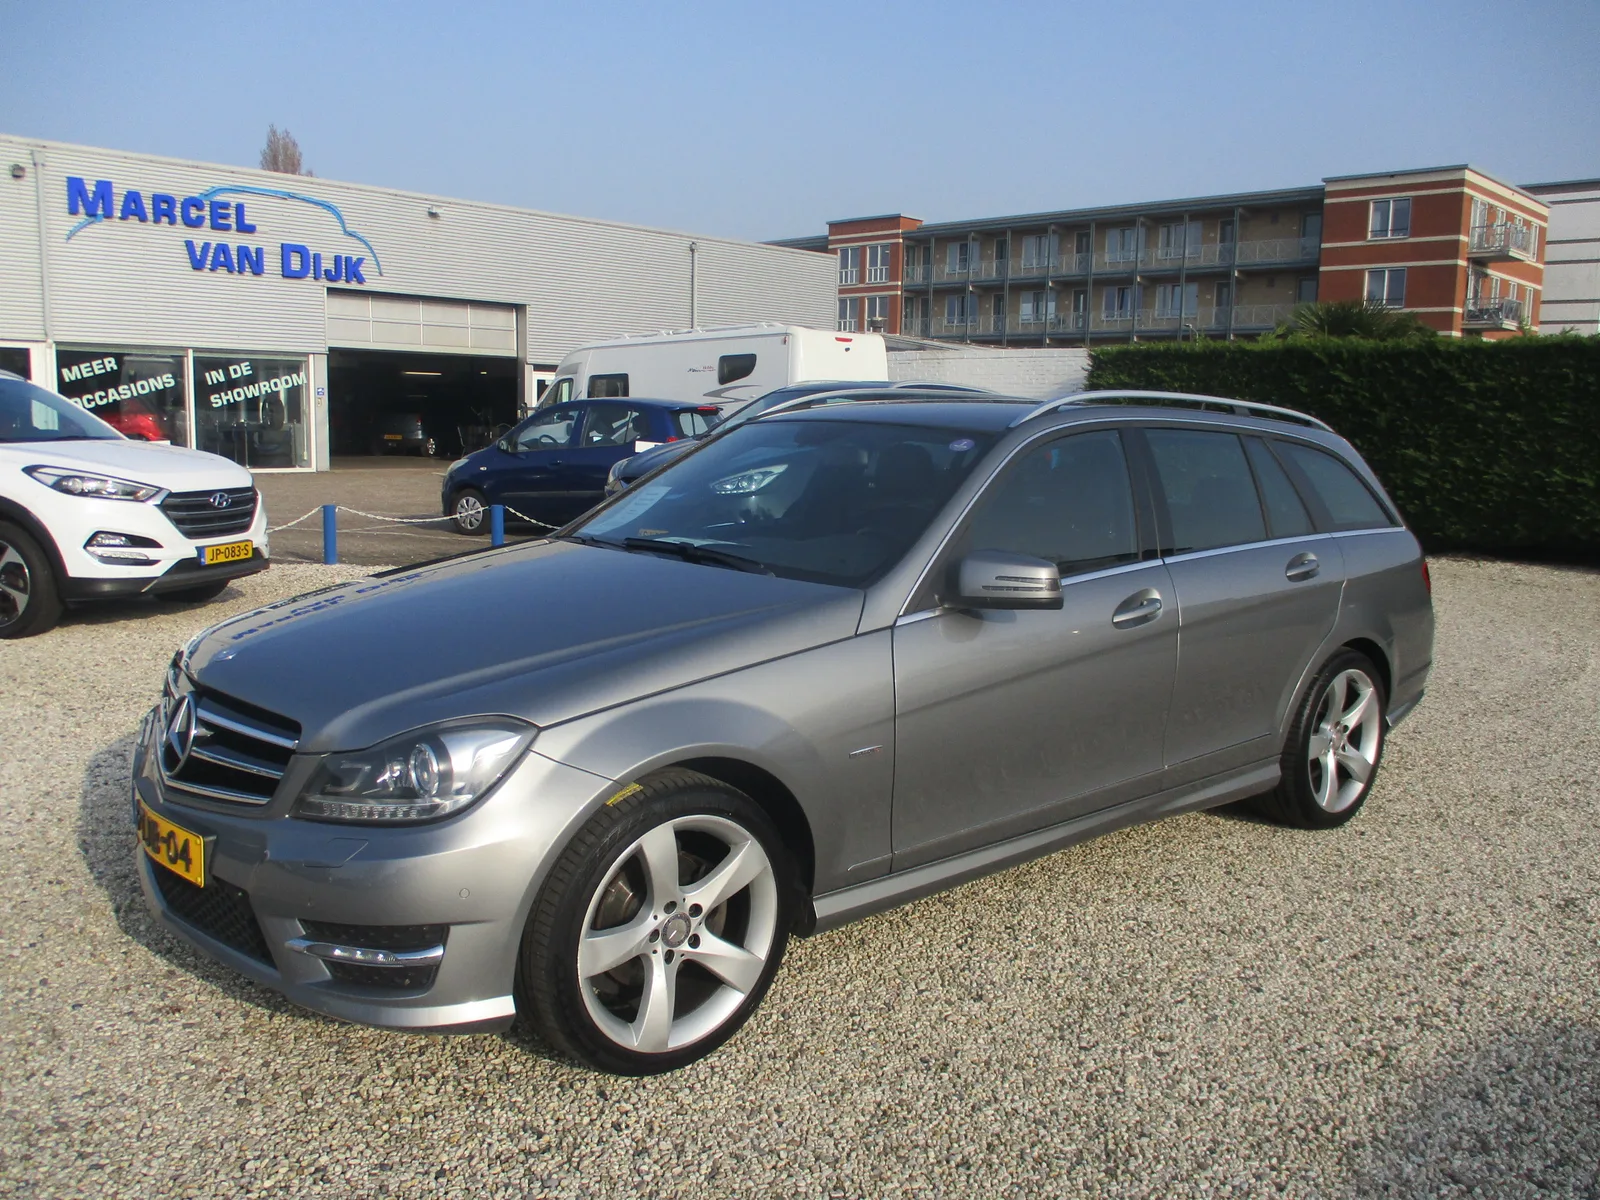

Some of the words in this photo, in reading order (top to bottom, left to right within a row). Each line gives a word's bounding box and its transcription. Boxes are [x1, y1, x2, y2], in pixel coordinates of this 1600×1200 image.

[66, 177, 256, 234] MARCEL
[184, 239, 264, 276] VAN
[280, 242, 367, 284] DIJK
[61, 356, 118, 383] MEER
[204, 368, 226, 386] IN
[228, 361, 253, 379] DE
[209, 371, 308, 409] SHOWROOM
[210, 544, 249, 561] JP-083-S
